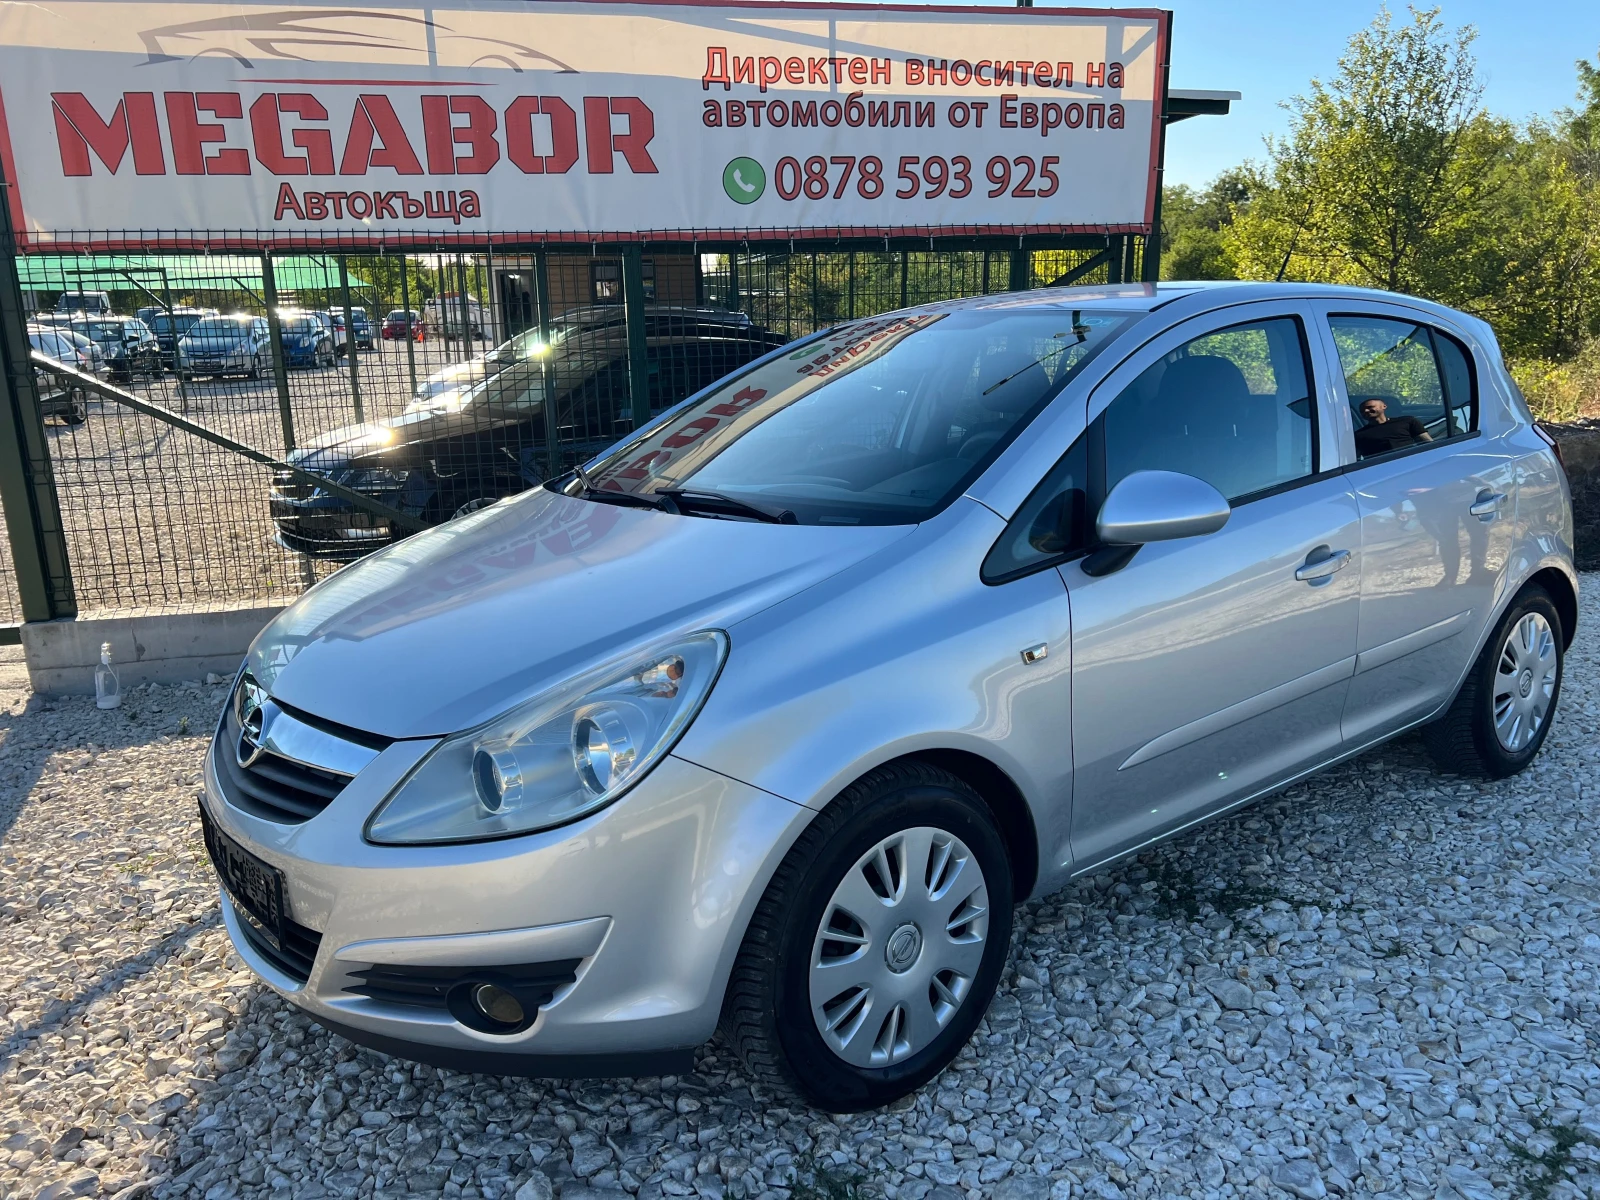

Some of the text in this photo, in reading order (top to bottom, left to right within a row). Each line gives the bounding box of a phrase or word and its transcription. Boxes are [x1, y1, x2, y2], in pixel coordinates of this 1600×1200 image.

[701, 46, 1125, 94] Директен вносител на
[51, 91, 660, 177] MEGABOR
[702, 90, 1125, 138] автомобили от Европа
[774, 155, 1060, 202] 0878 593 925
[273, 182, 482, 226] Автокъща
